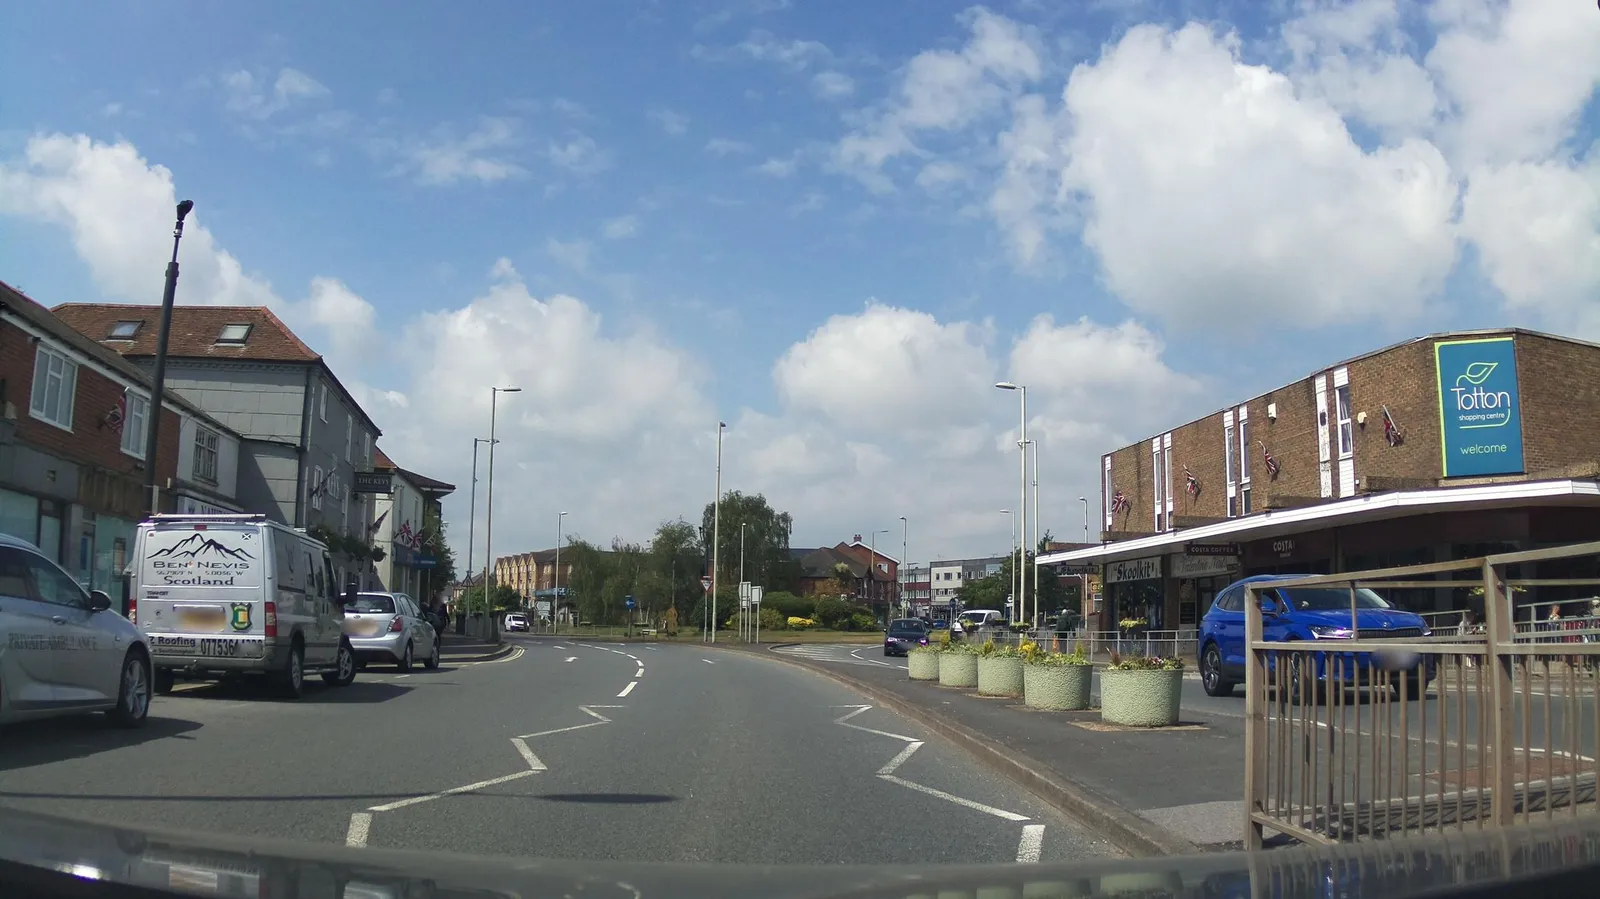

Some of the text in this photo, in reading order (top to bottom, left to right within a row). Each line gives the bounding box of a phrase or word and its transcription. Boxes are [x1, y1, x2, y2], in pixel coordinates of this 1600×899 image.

[1450, 386, 1511, 411] Totton
[1459, 411, 1505, 422] shopping centre
[1460, 443, 1507, 455] welcome
[1273, 539, 1291, 552] COSTA
[153, 560, 250, 570] BEN NEVIS
[163, 575, 235, 586] Scotland
[157, 636, 196, 648] Roofing
